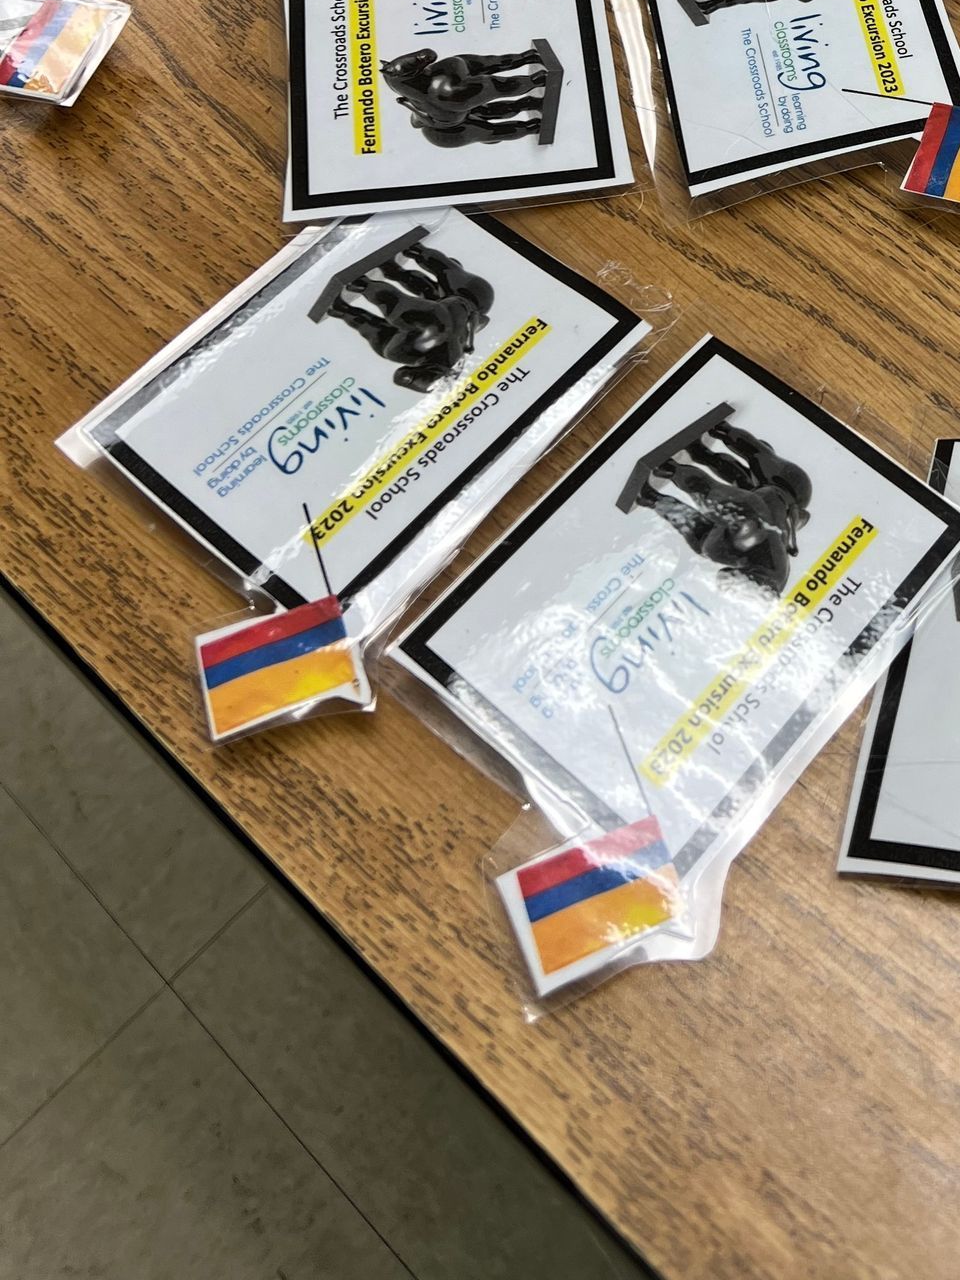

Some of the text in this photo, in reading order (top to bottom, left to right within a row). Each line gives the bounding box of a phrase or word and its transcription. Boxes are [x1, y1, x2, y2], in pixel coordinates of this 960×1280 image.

[489, 13, 500, 30] The
[773, 21, 798, 82] classrooms
[777, 12, 829, 91] living
[860, 4, 886, 60] Excursion
[877, 61, 899, 94] 2023
[888, 19, 914, 59] School
[330, 24, 348, 90] Crossroads
[358, 42, 373, 86] Botero
[741, 27, 775, 137] The Crossroads School
[333, 93, 349, 120] The
[358, 89, 376, 154] Fernando
[780, 105, 794, 133] doing
[791, 92, 807, 130] learning
[364, 366, 531, 521] The Crossroads School
